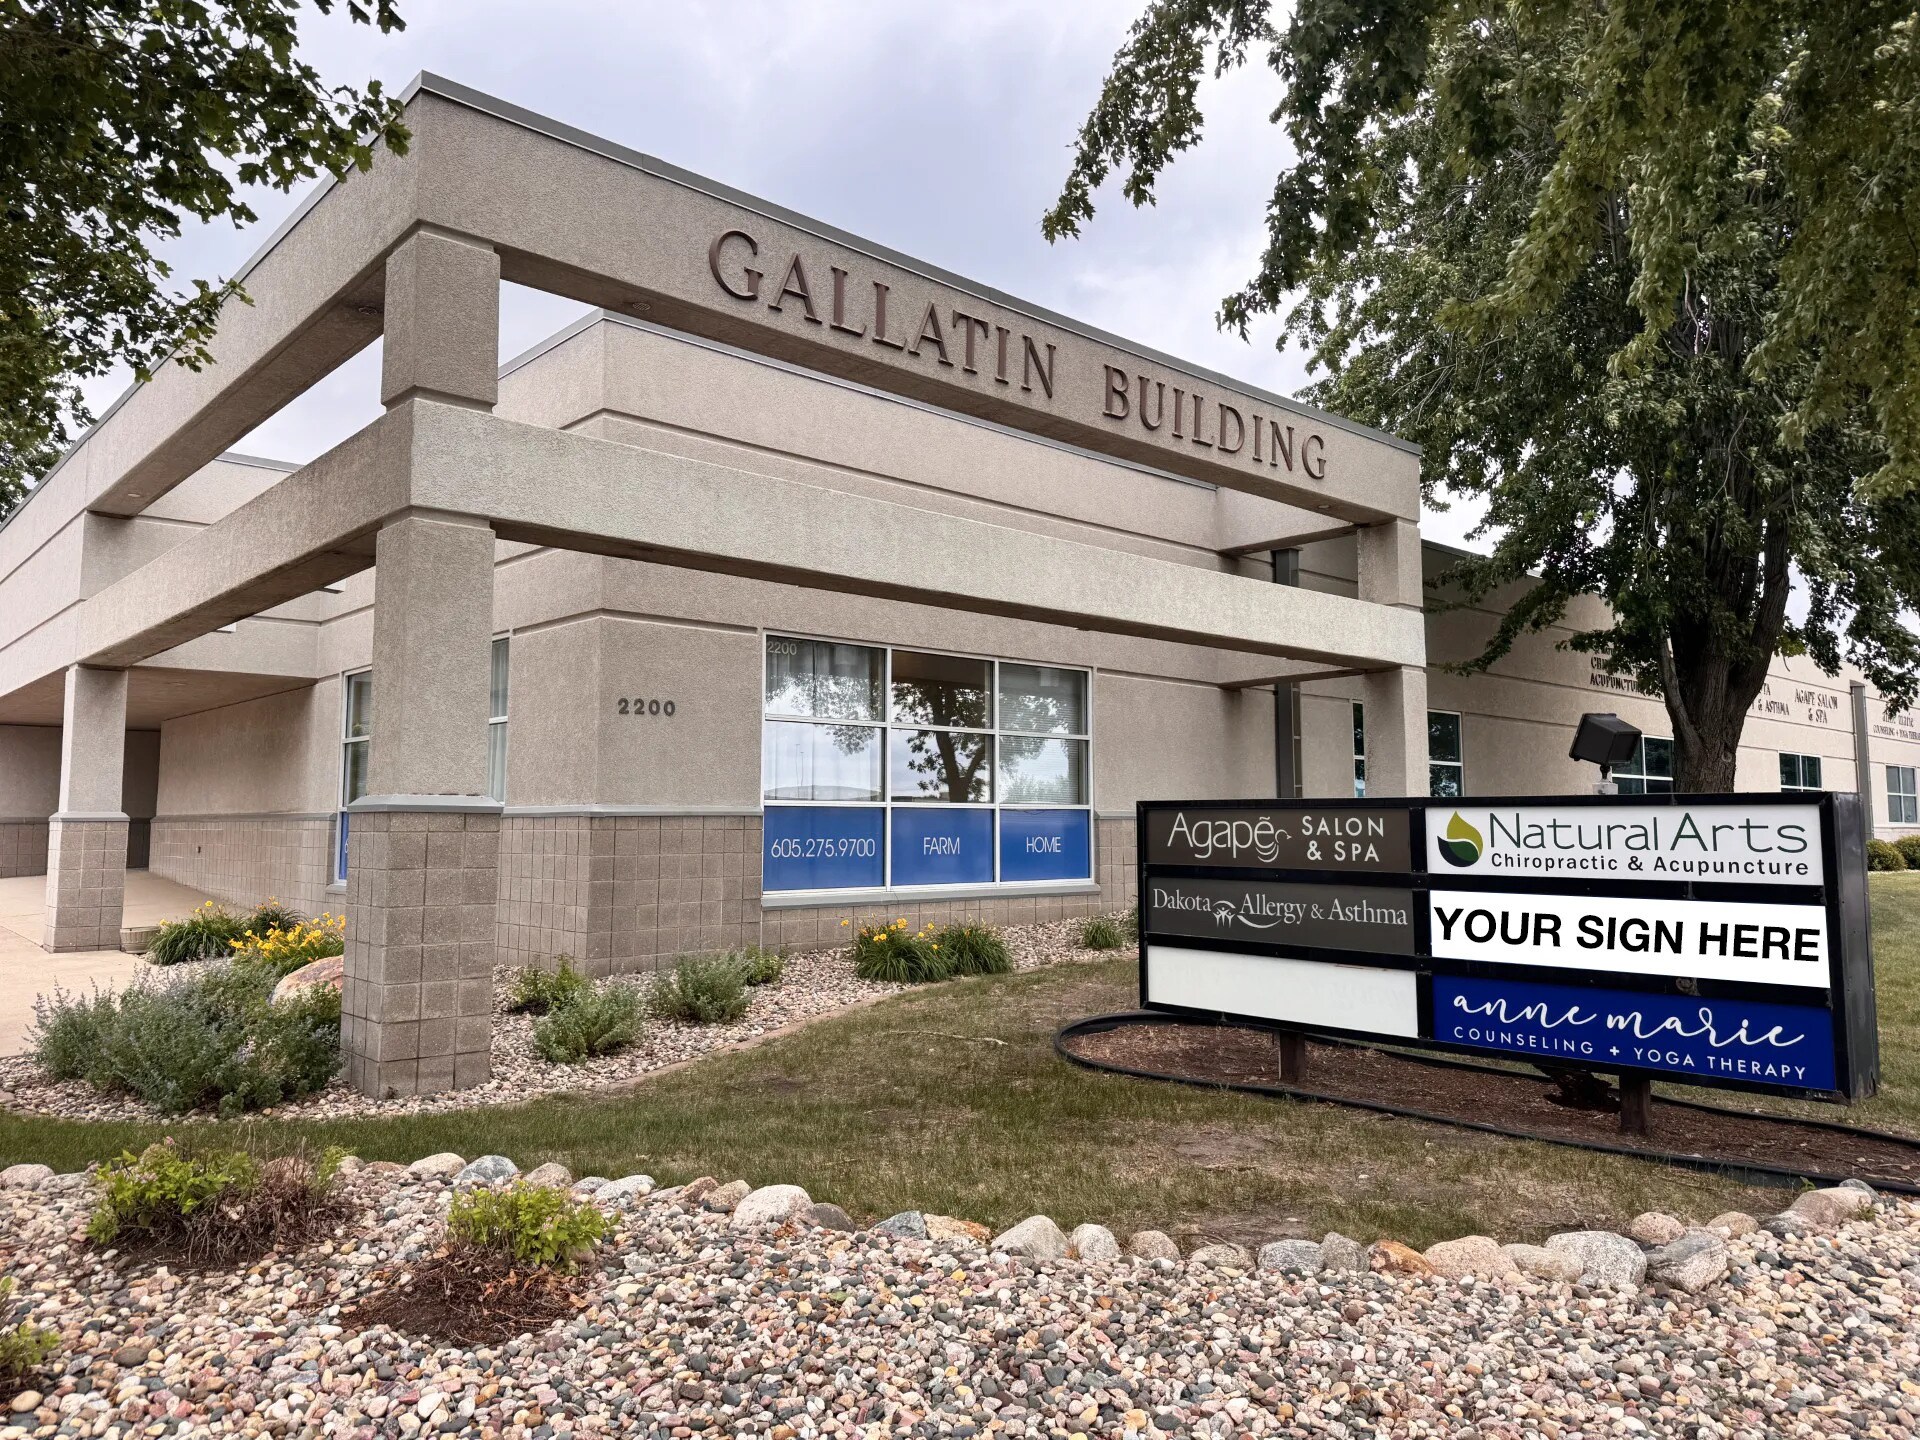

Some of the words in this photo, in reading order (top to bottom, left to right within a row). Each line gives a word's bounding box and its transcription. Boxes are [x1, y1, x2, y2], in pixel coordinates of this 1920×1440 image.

[708, 229, 1057, 398] GALLATIN
[1102, 363, 1327, 480] BUILDING
[766, 641, 797, 656] 2200
[618, 698, 676, 717] 2200
[1301, 815, 1384, 837] SALON
[1489, 812, 1659, 851] Natural
[1670, 812, 1808, 853] Arts
[770, 837, 876, 858] 605.275.9700
[923, 837, 961, 856] FARM
[1026, 836, 1062, 853] HOME
[1306, 840, 1323, 861] &
[1333, 841, 1380, 862] SPA
[1491, 852, 1618, 872] Chiropractic
[1627, 856, 1644, 872] &
[1653, 856, 1809, 876] Acupuncture
[1152, 888, 1212, 913] Dakota
[1239, 893, 1307, 925] Allergy
[1310, 903, 1325, 920] &
[1328, 898, 1409, 926] Asthma
[1433, 906, 1562, 947] YOUR
[1576, 914, 1684, 954] SIGN
[1699, 922, 1821, 962] HERE
[1453, 994, 1598, 1029] anne
[1606, 1007, 1805, 1048] marie
[1454, 1026, 1594, 1055] COUNSELING
[1609, 1045, 1620, 1057] +
[1633, 1048, 1696, 1067] YOGA
[1706, 1056, 1807, 1080] THERAPY
